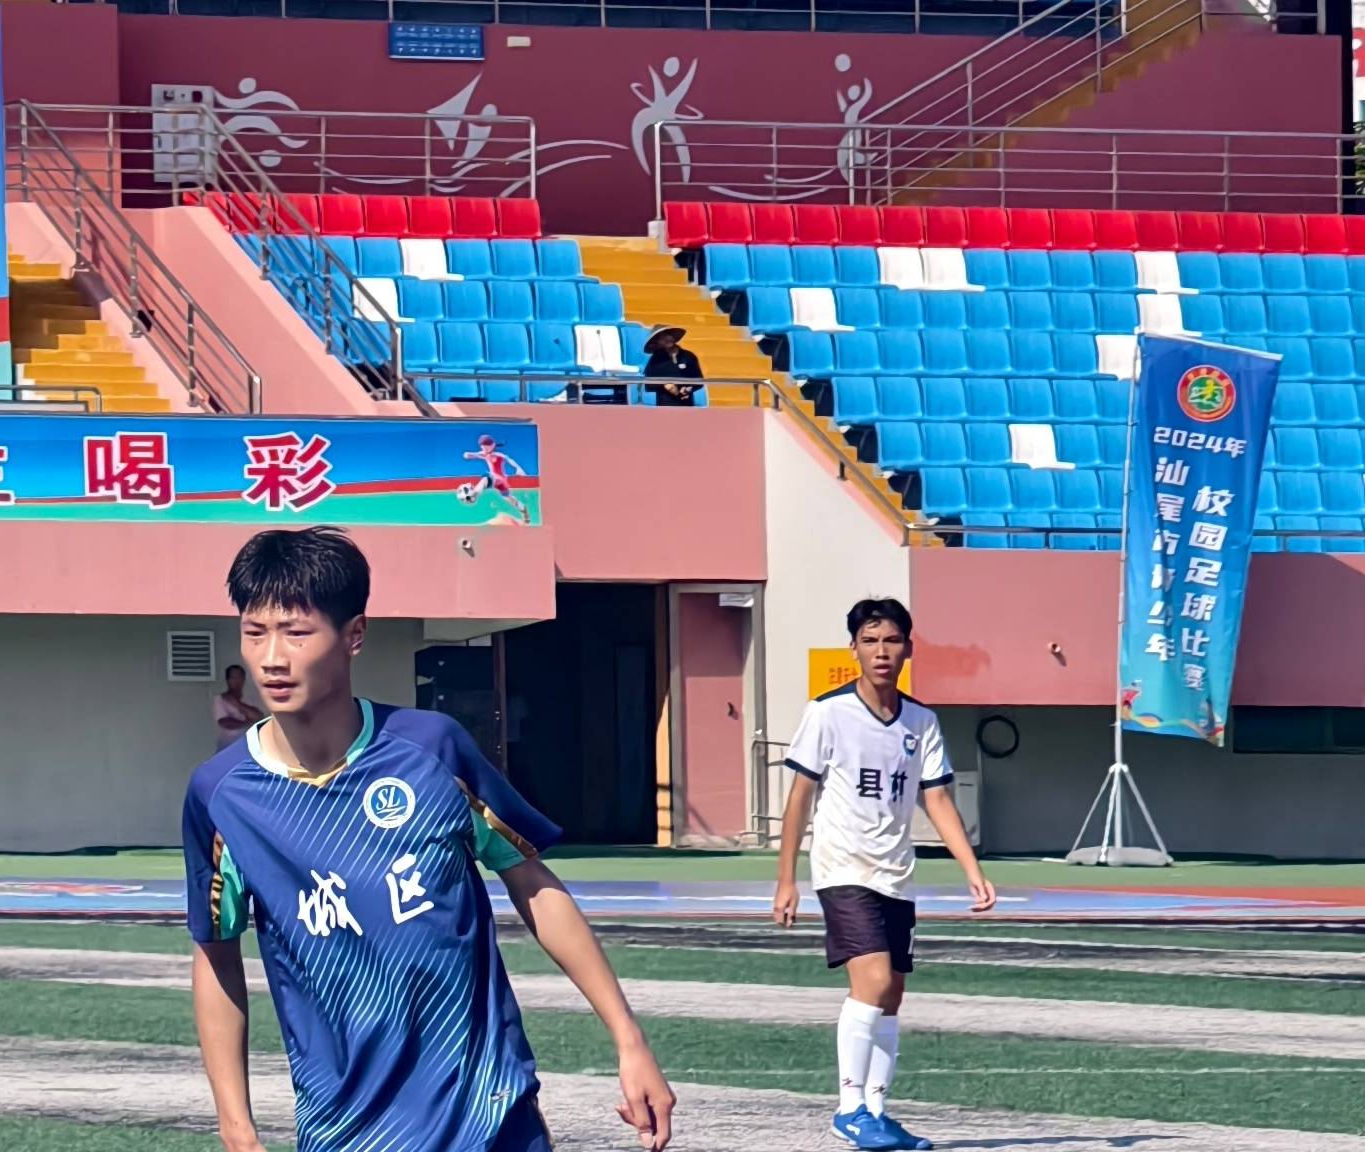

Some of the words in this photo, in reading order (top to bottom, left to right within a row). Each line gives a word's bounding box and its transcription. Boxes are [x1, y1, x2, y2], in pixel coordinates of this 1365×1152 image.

[1152, 425, 1248, 459] 2024年
[1180, 484, 1236, 694] 校园足球比赛
[296, 853, 435, 937] 城区
